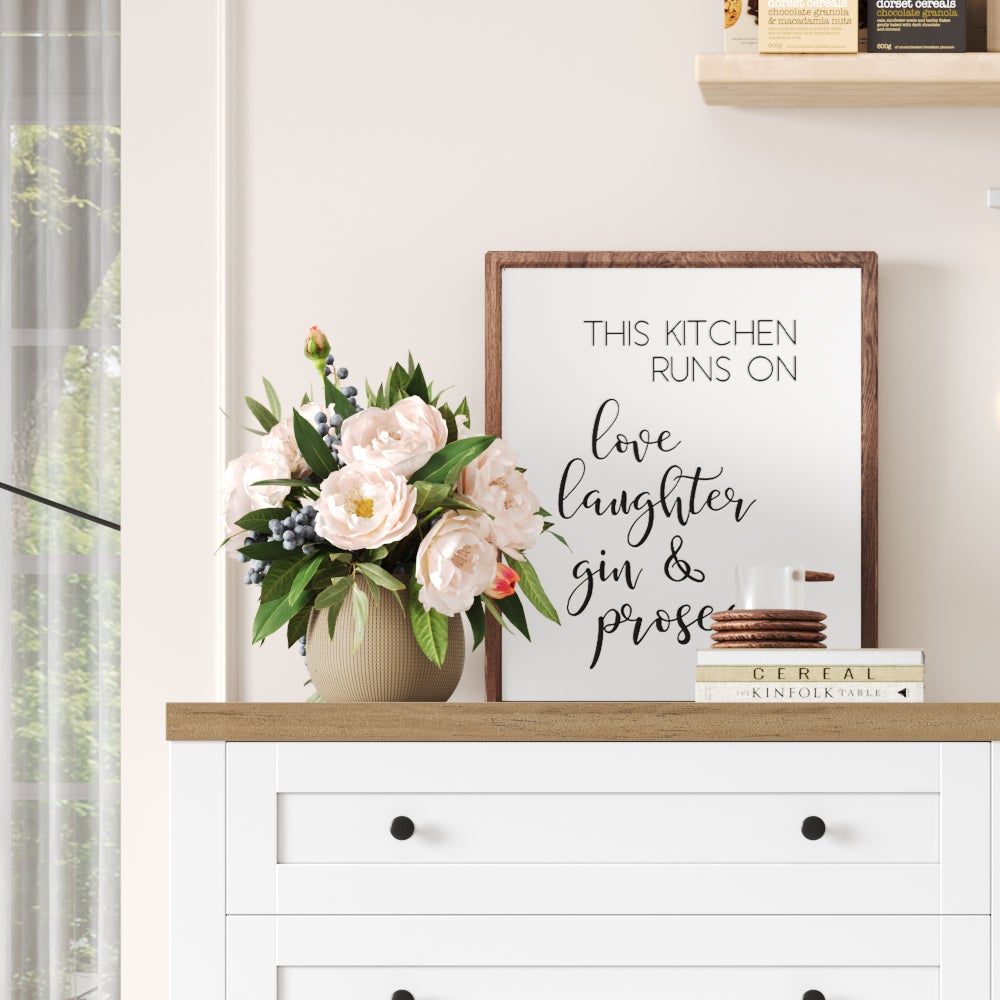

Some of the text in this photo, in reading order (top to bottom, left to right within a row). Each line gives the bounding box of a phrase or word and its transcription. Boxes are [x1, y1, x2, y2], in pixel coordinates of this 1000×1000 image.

[768, 0, 848, 8] dorset cereals
[876, 0, 957, 9] dorset cereals
[768, 8, 850, 18] chocolate granola
[876, 9, 958, 18] chocolate granola
[768, 17, 852, 25] & macadamia nuts
[583, 319, 798, 347] THIS KITCHEN
[652, 355, 798, 383] RUNS ON
[591, 398, 682, 463] love
[557, 457, 758, 548] laughter
[566, 535, 706, 617] gin &
[589, 603, 736, 670] prose
[752, 667, 876, 680] CEREAL
[751, 687, 835, 698] KINFOLK
[838, 688, 882, 697] TABLE
